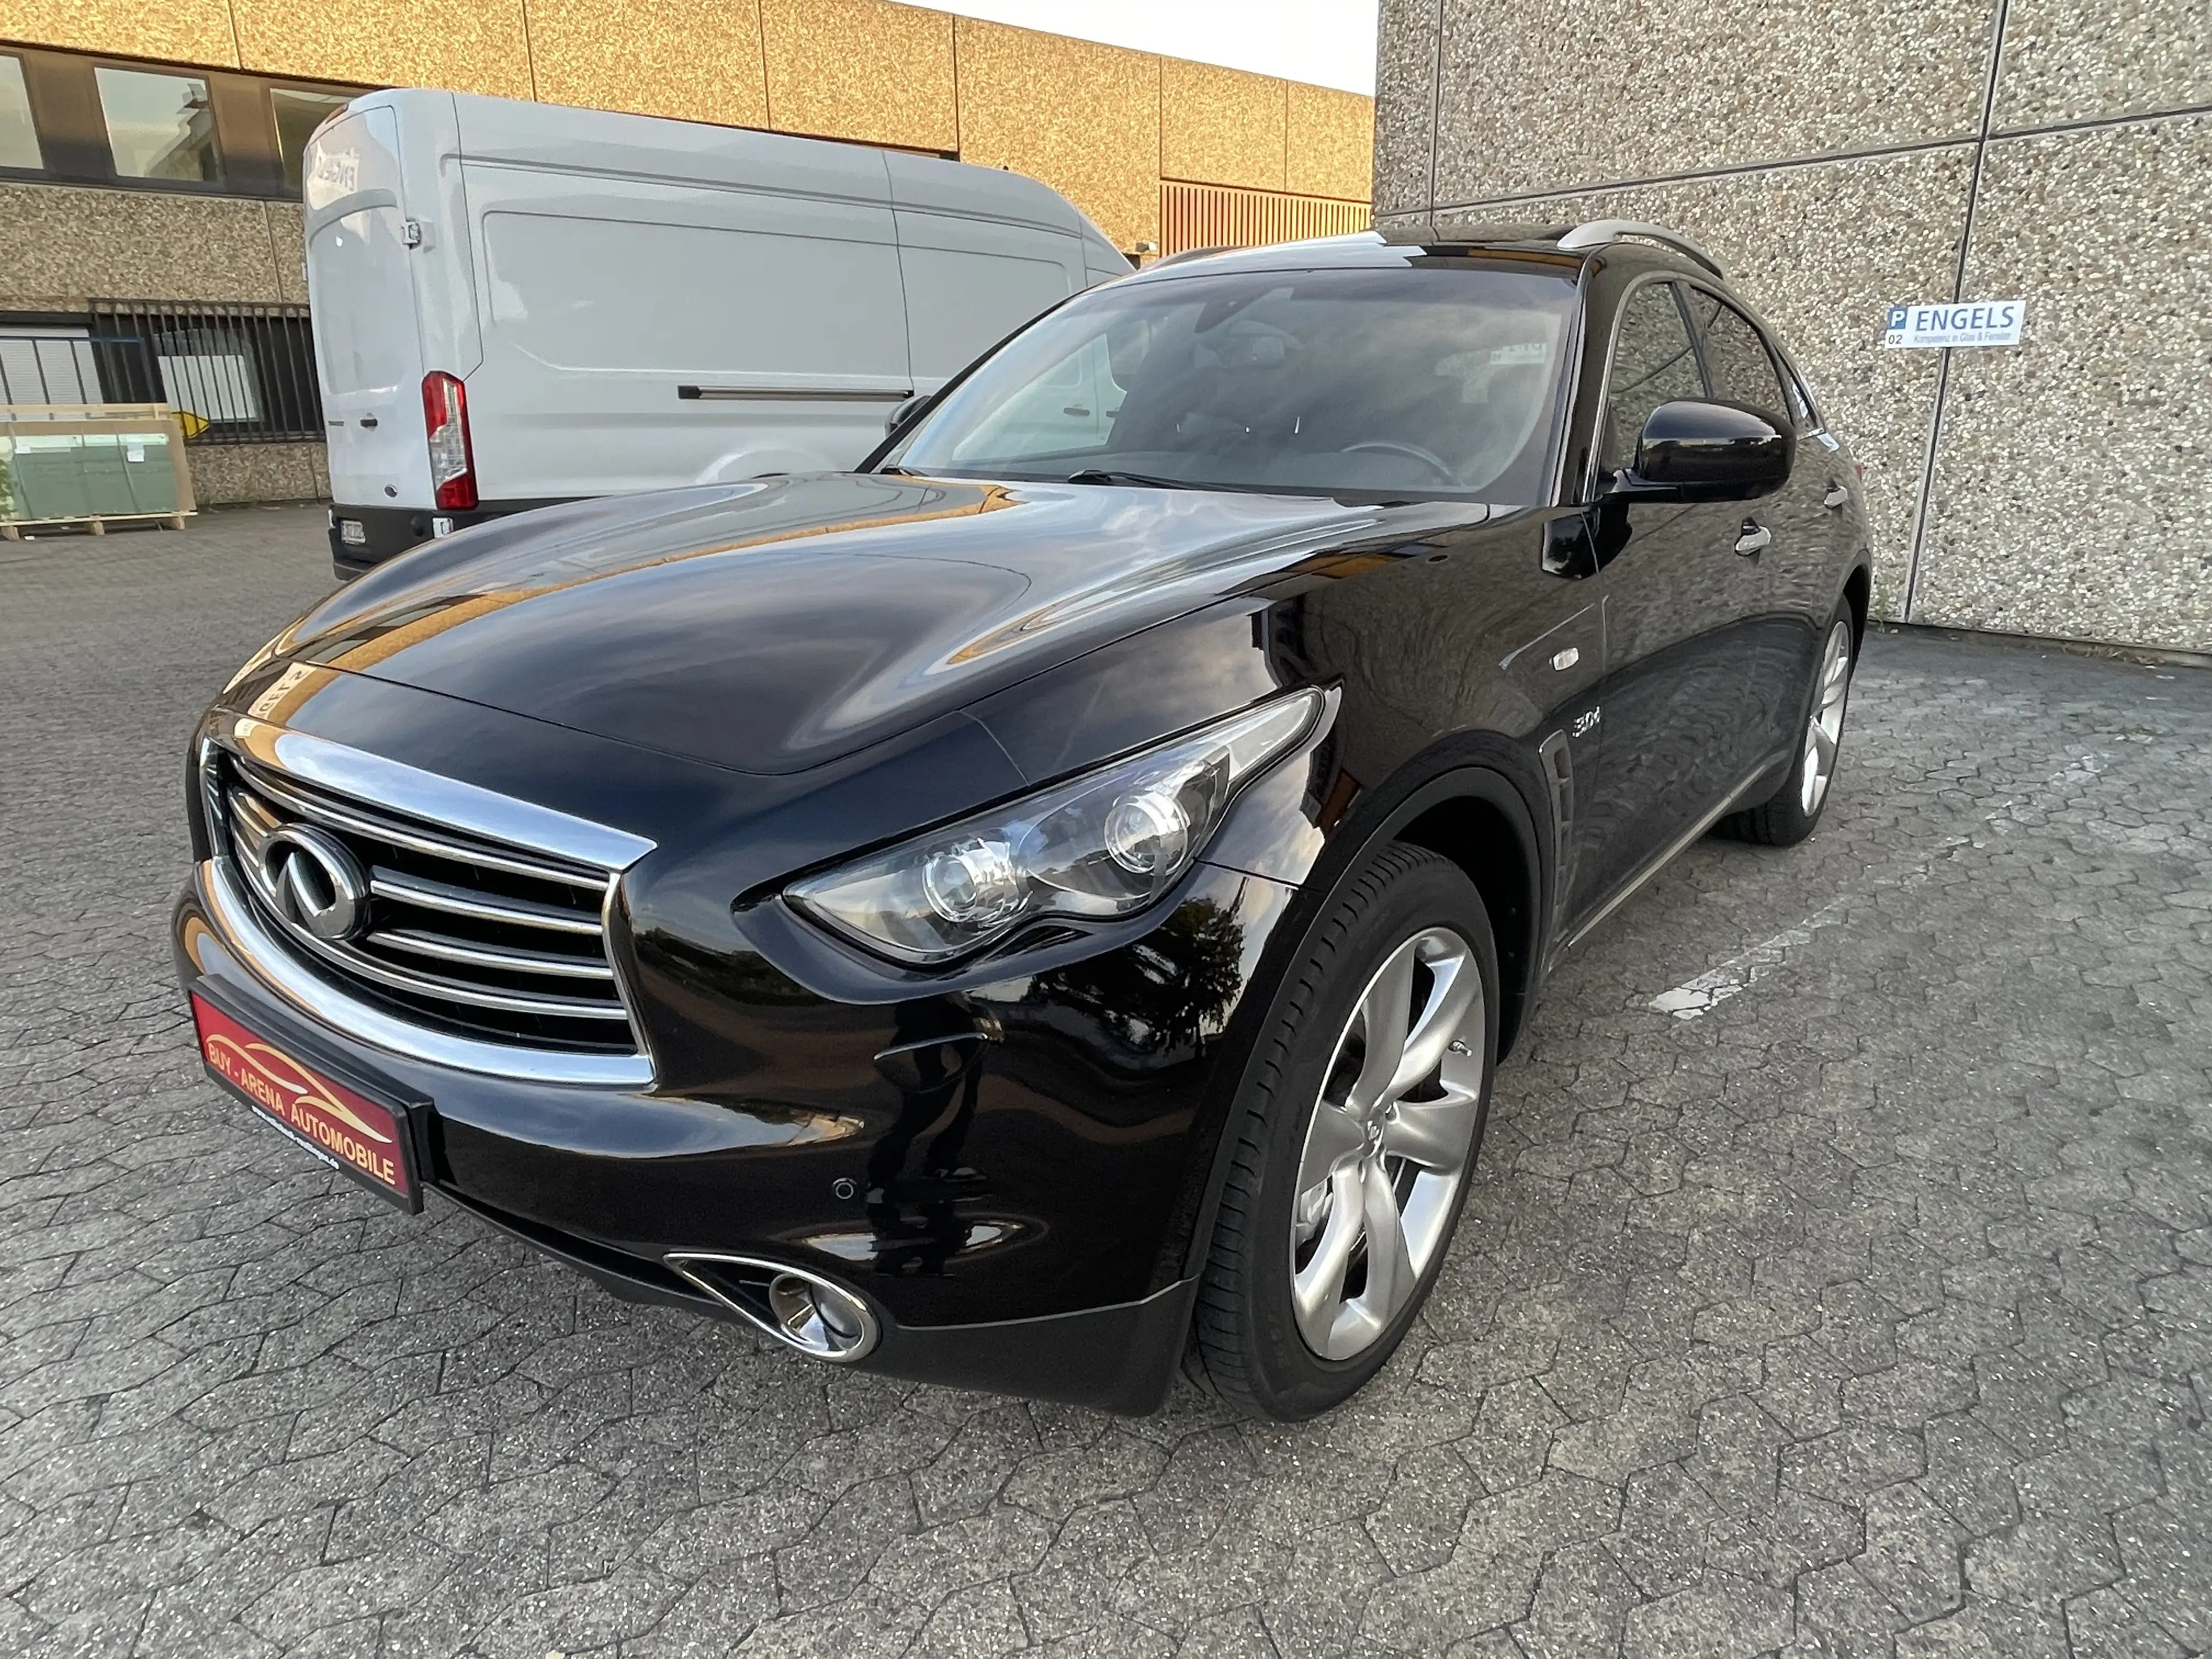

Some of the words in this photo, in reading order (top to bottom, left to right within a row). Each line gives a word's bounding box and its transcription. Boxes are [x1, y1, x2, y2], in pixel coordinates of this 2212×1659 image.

[1891, 310, 1906, 327] P
[1915, 306, 2014, 331] ENGELS
[1888, 334, 1903, 344] 02
[208, 1042, 231, 1076] BUY
[241, 1067, 286, 1116] ARENA
[291, 1103, 396, 1185] AUTOMOBILE
